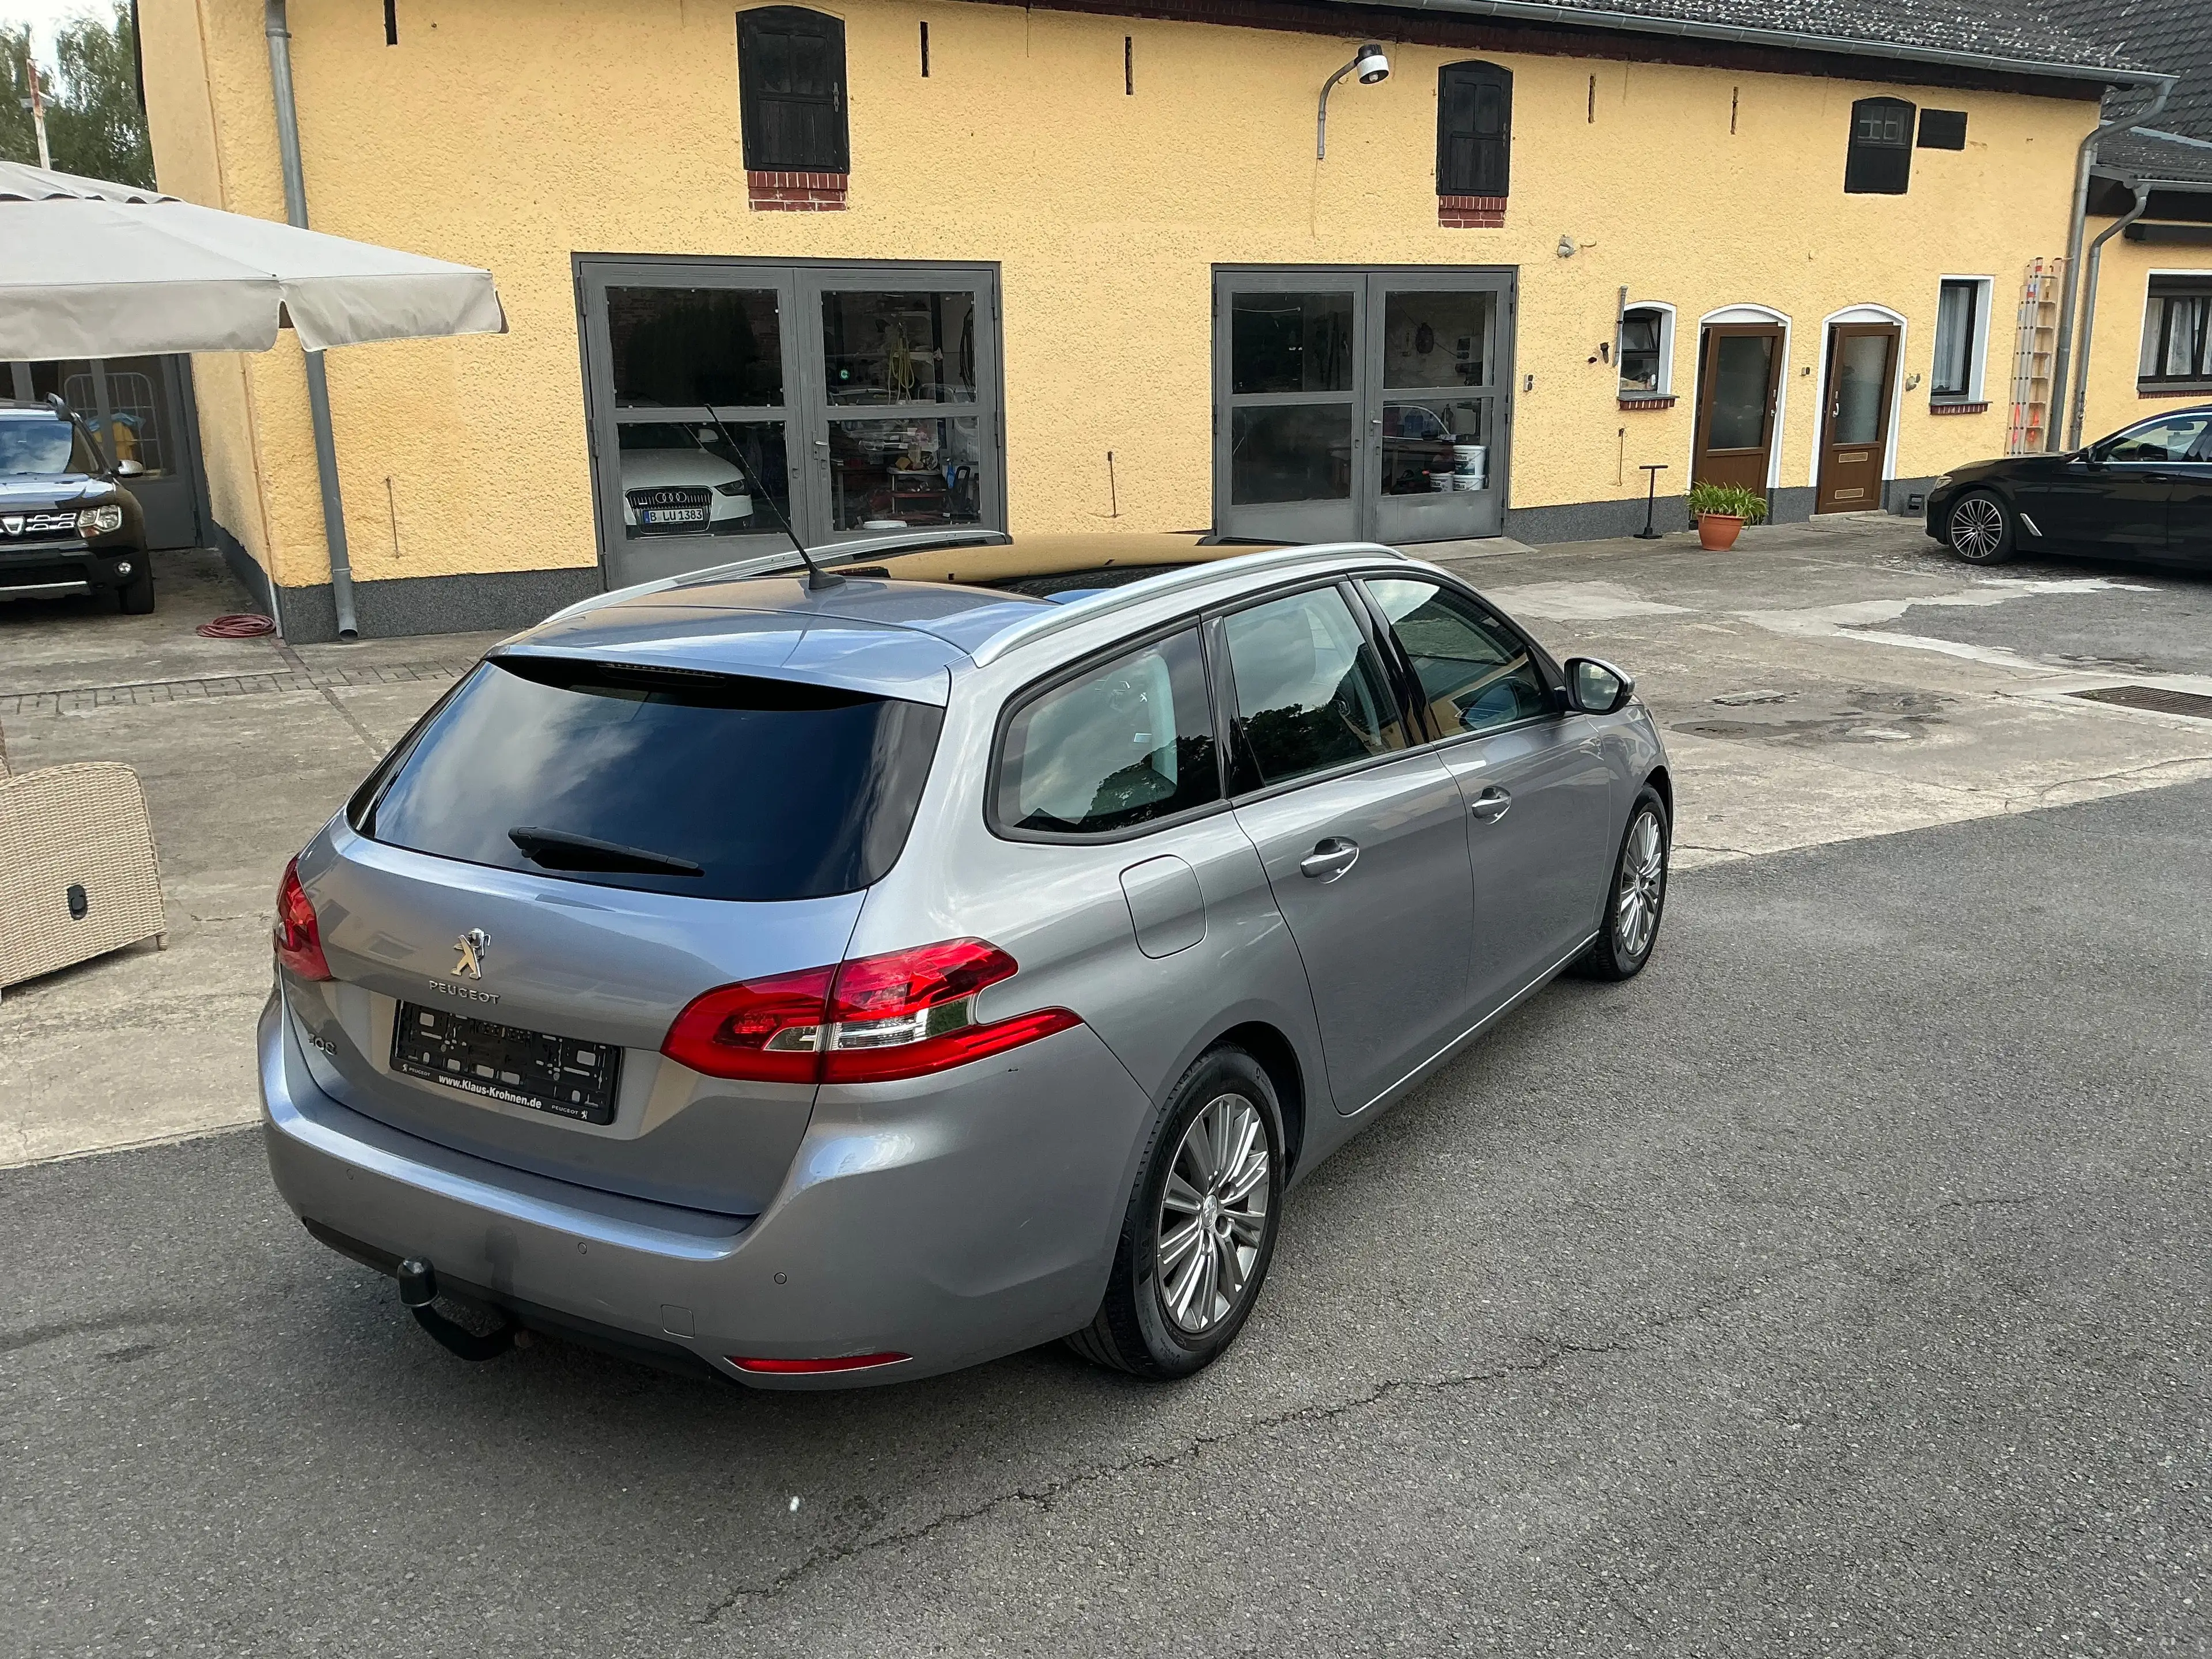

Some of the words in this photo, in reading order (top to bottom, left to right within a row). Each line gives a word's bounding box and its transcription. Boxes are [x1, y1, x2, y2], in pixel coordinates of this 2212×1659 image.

[650, 512, 657, 521] B
[429, 980, 499, 1004] PEUGEOT
[438, 1075, 542, 1109] www.Klaus-Krohnen.de
[551, 1105, 579, 1115] PEUGEOT
